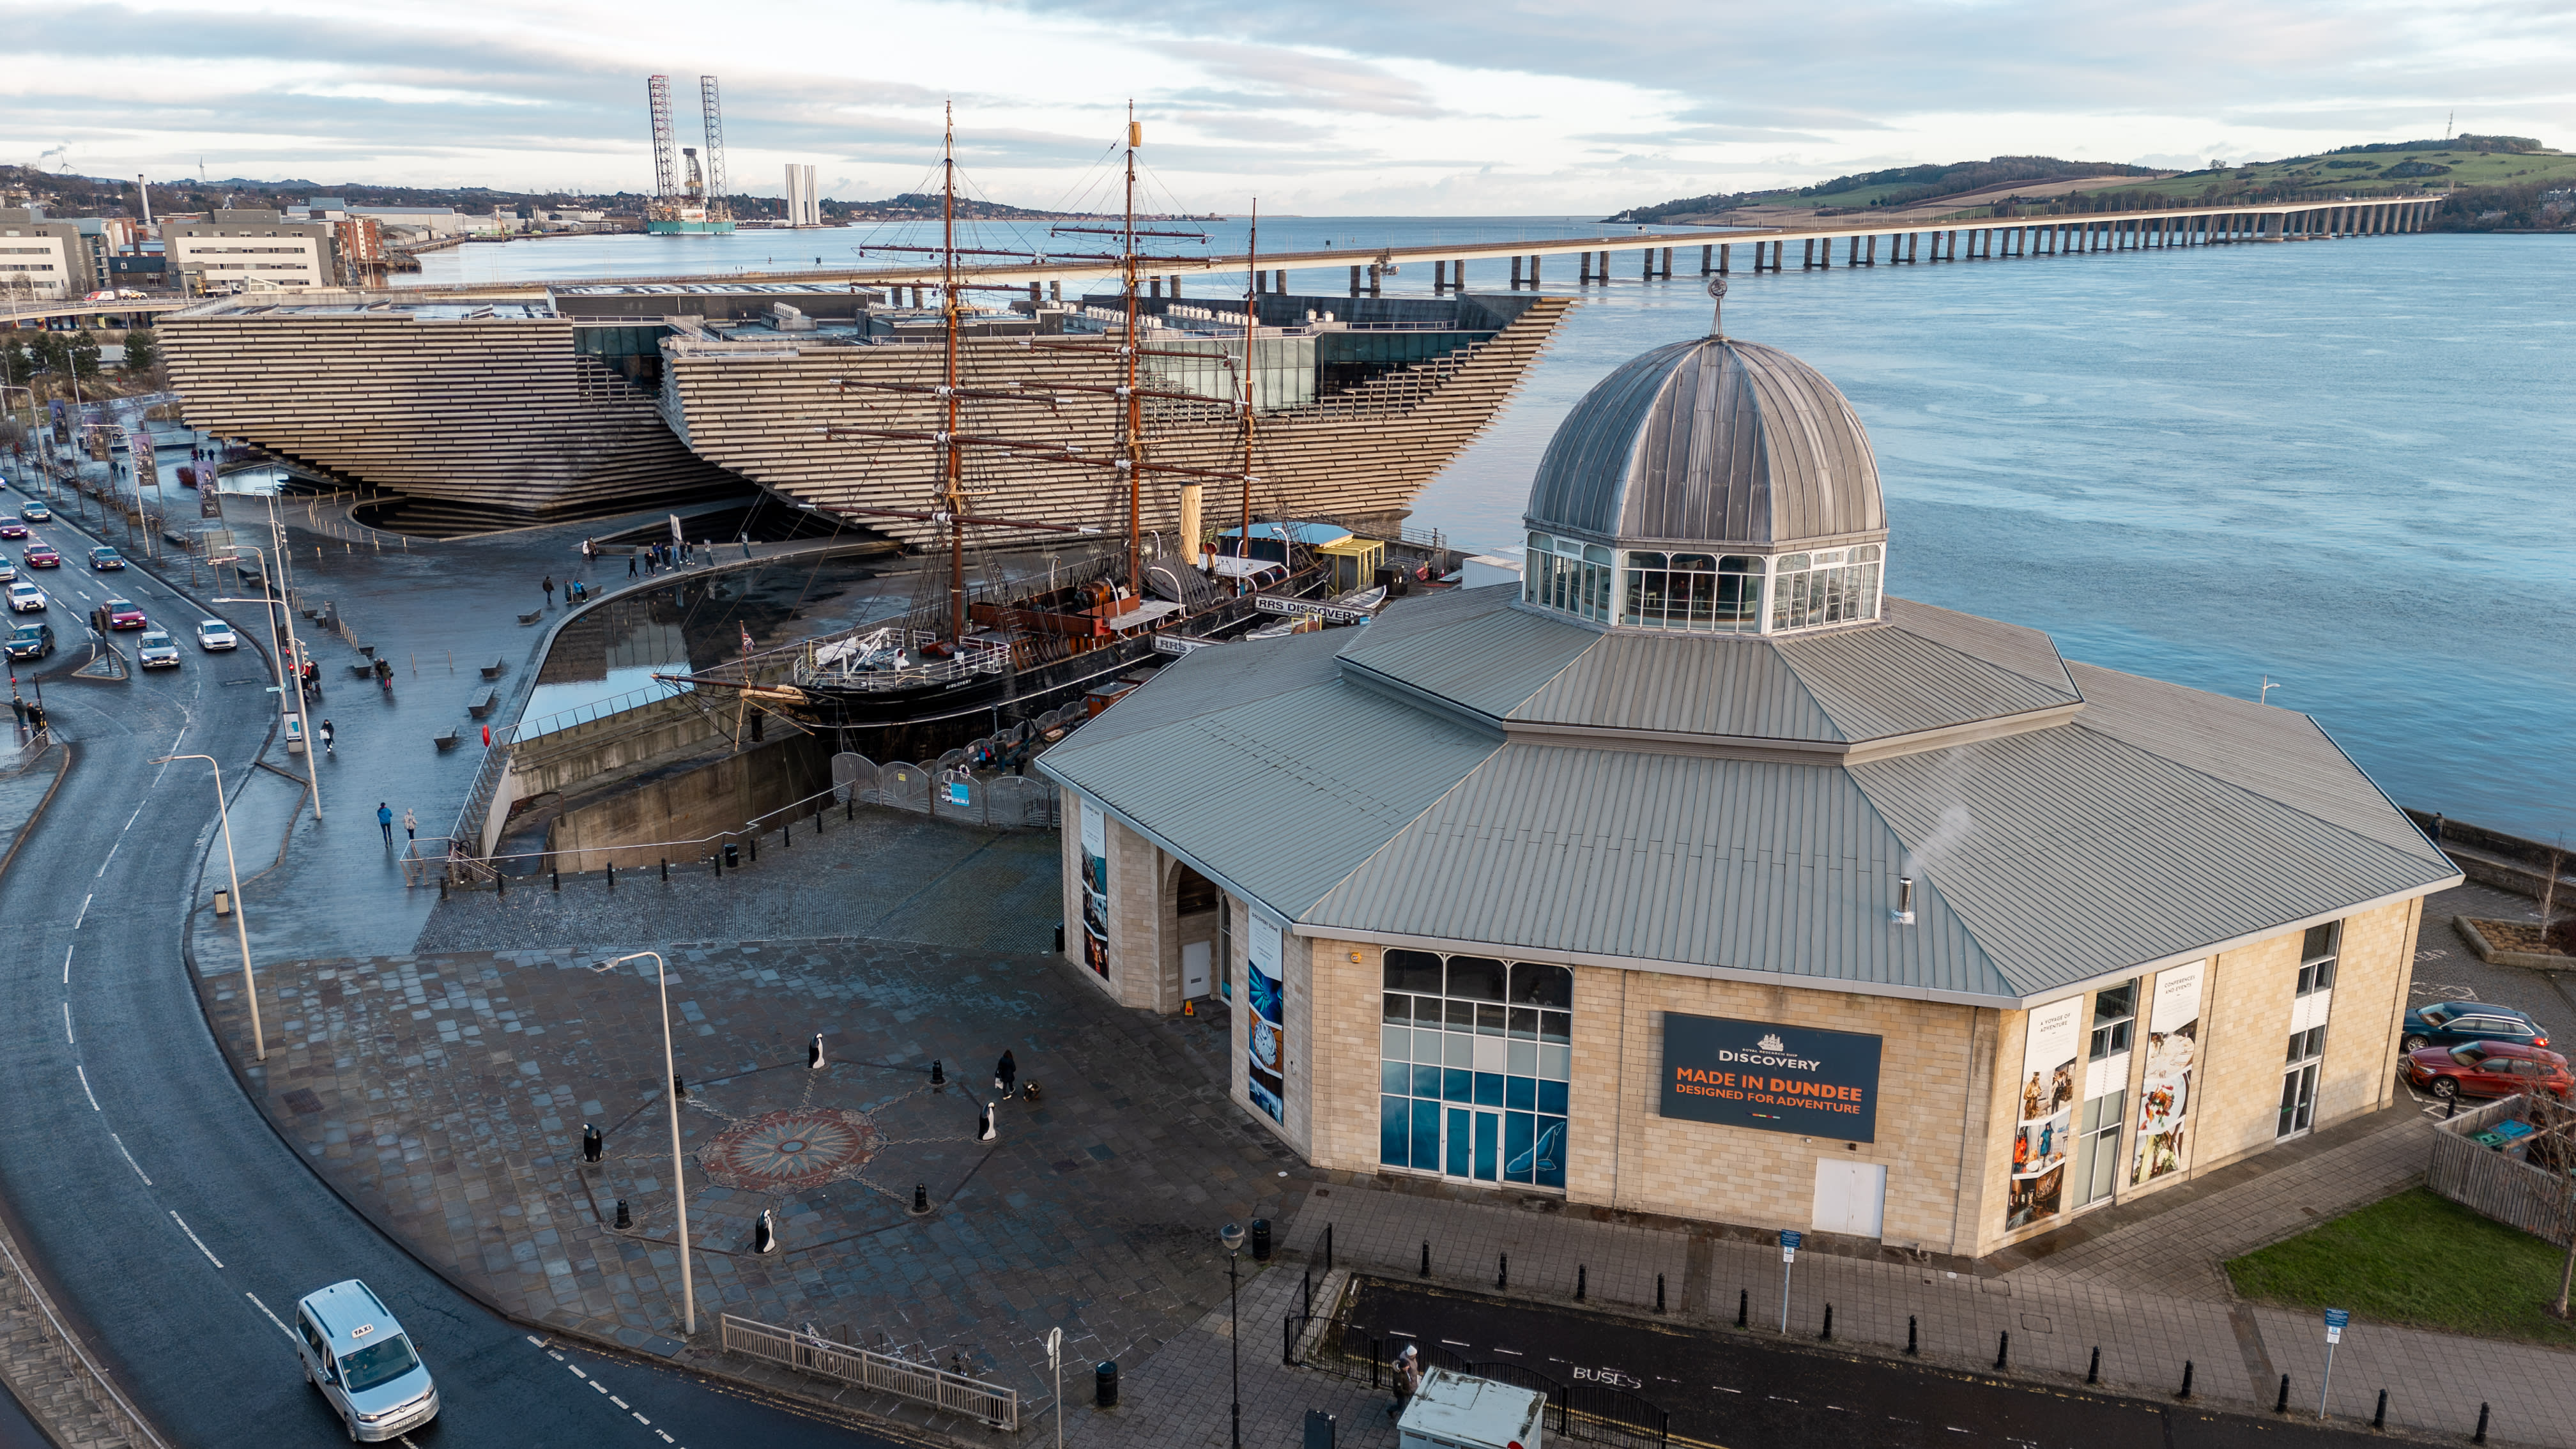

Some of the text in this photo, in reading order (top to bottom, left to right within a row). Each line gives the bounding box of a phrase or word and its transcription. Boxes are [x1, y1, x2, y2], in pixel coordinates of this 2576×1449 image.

[1259, 599, 1358, 619] RRS DISCOVERY
[2164, 975, 2196, 988] CONFERENCES
[2040, 1020, 2068, 1032] ADVENTURE
[2045, 1015, 2063, 1024] VOYAGE
[1719, 1049, 1821, 1072] DISCOVERY
[1676, 1066, 1863, 1102] MADE IN DUNDEE
[1676, 1084, 1861, 1114] DESIGNED FOR ADVENTURE
[354, 1325, 372, 1336] TAXI
[1573, 1367, 1641, 1389] BUSES
